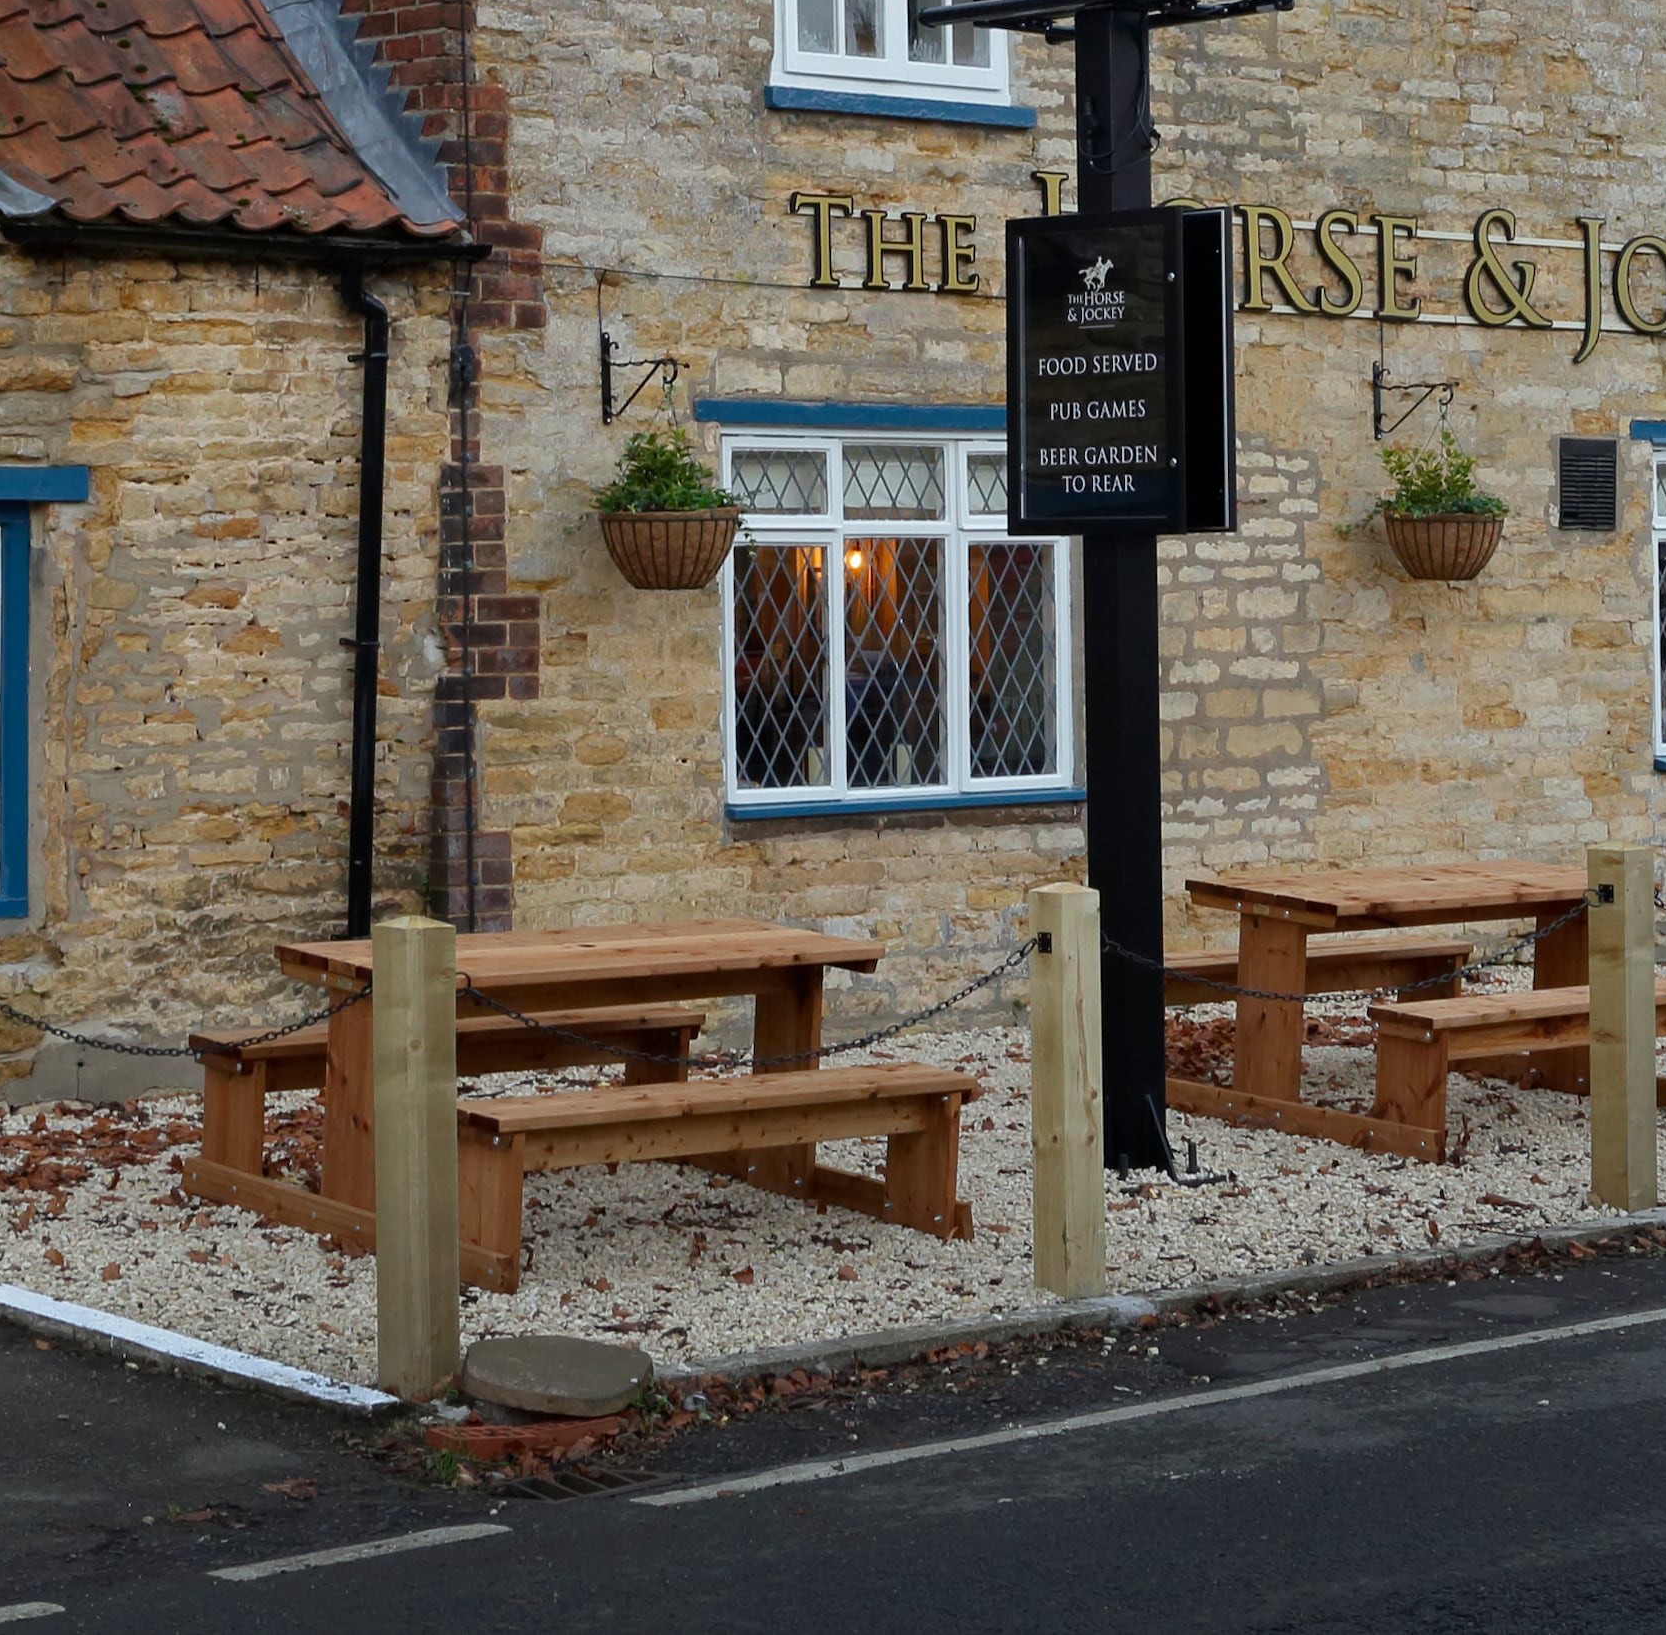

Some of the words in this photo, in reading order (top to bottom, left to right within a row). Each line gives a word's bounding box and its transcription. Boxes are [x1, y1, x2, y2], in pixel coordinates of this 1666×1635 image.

[789, 192, 980, 292] THE
[1033, 170, 1422, 321] RSE
[1465, 207, 1554, 328] &
[1067, 293, 1083, 304] THE
[1084, 291, 1125, 306] HORSE
[1067, 307, 1078, 322] &
[1080, 306, 1125, 325] JOCKEY
[1038, 356, 1087, 376] FOOD
[1092, 353, 1158, 374] SERVED
[1050, 402, 1081, 421] PUB
[1087, 399, 1146, 419] GAMES
[1039, 447, 1079, 466] BEER
[1084, 445, 1158, 465] GARDEN
[1062, 475, 1086, 493] TO
[1091, 474, 1136, 492] REAR
